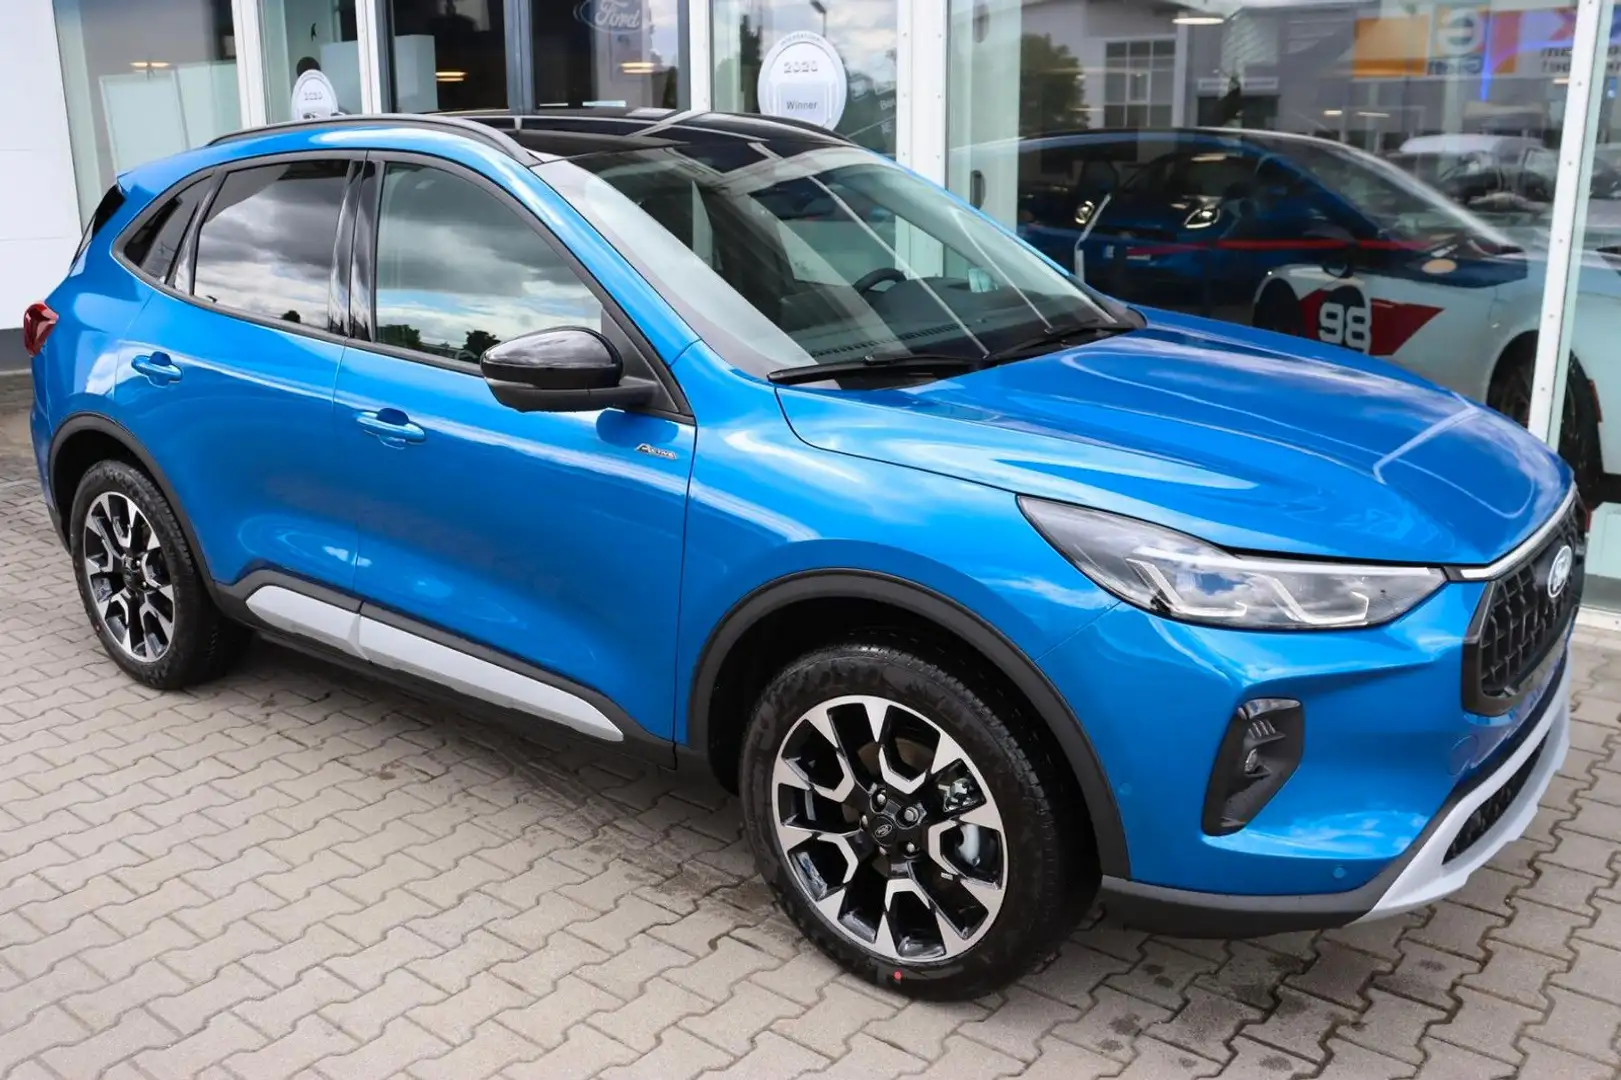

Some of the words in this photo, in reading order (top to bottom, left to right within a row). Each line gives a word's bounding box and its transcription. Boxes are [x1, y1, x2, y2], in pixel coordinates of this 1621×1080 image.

[595, 0, 640, 29] Ford
[786, 100, 818, 110] Winner
[1318, 301, 1372, 354] 98
